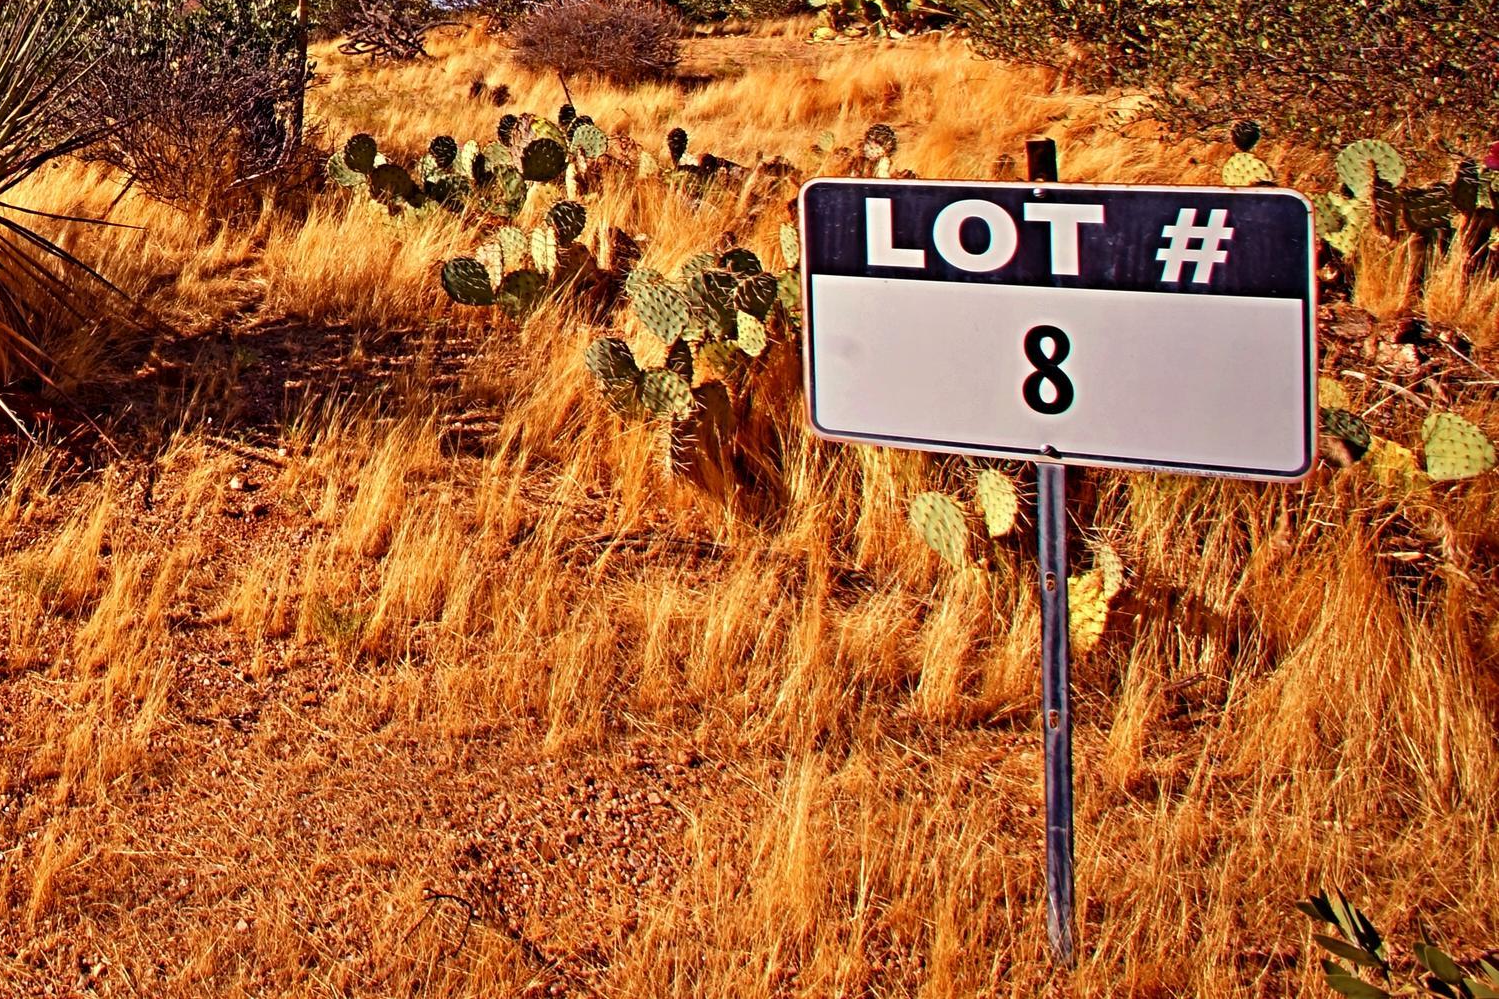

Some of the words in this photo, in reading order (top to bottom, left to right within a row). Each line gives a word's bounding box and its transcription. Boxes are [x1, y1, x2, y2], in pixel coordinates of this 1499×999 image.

[865, 197, 1105, 276] LOT
[1155, 208, 1235, 284] #
[1022, 325, 1075, 415] 8
